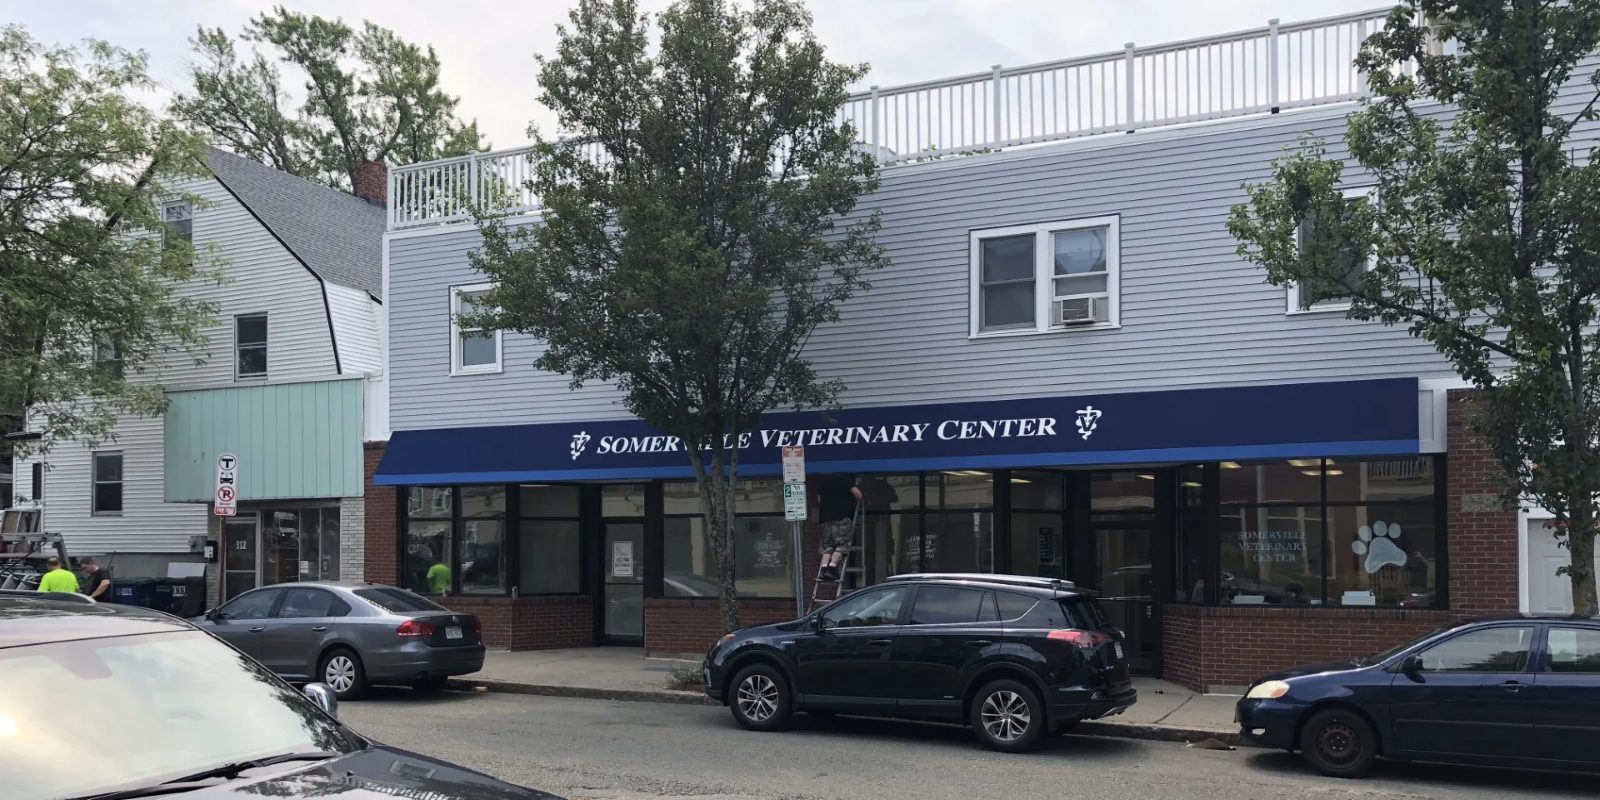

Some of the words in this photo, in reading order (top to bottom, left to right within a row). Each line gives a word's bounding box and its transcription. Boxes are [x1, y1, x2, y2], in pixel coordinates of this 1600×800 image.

[597, 432, 752, 454] SOMERLE
[760, 423, 930, 448] VETERINARY
[937, 417, 1057, 440] CENTER
[221, 458, 234, 468] T
[1239, 531, 1306, 539] SOMERVILLE
[1239, 542, 1306, 551] VETERINARY
[1253, 553, 1296, 562] CENTER
